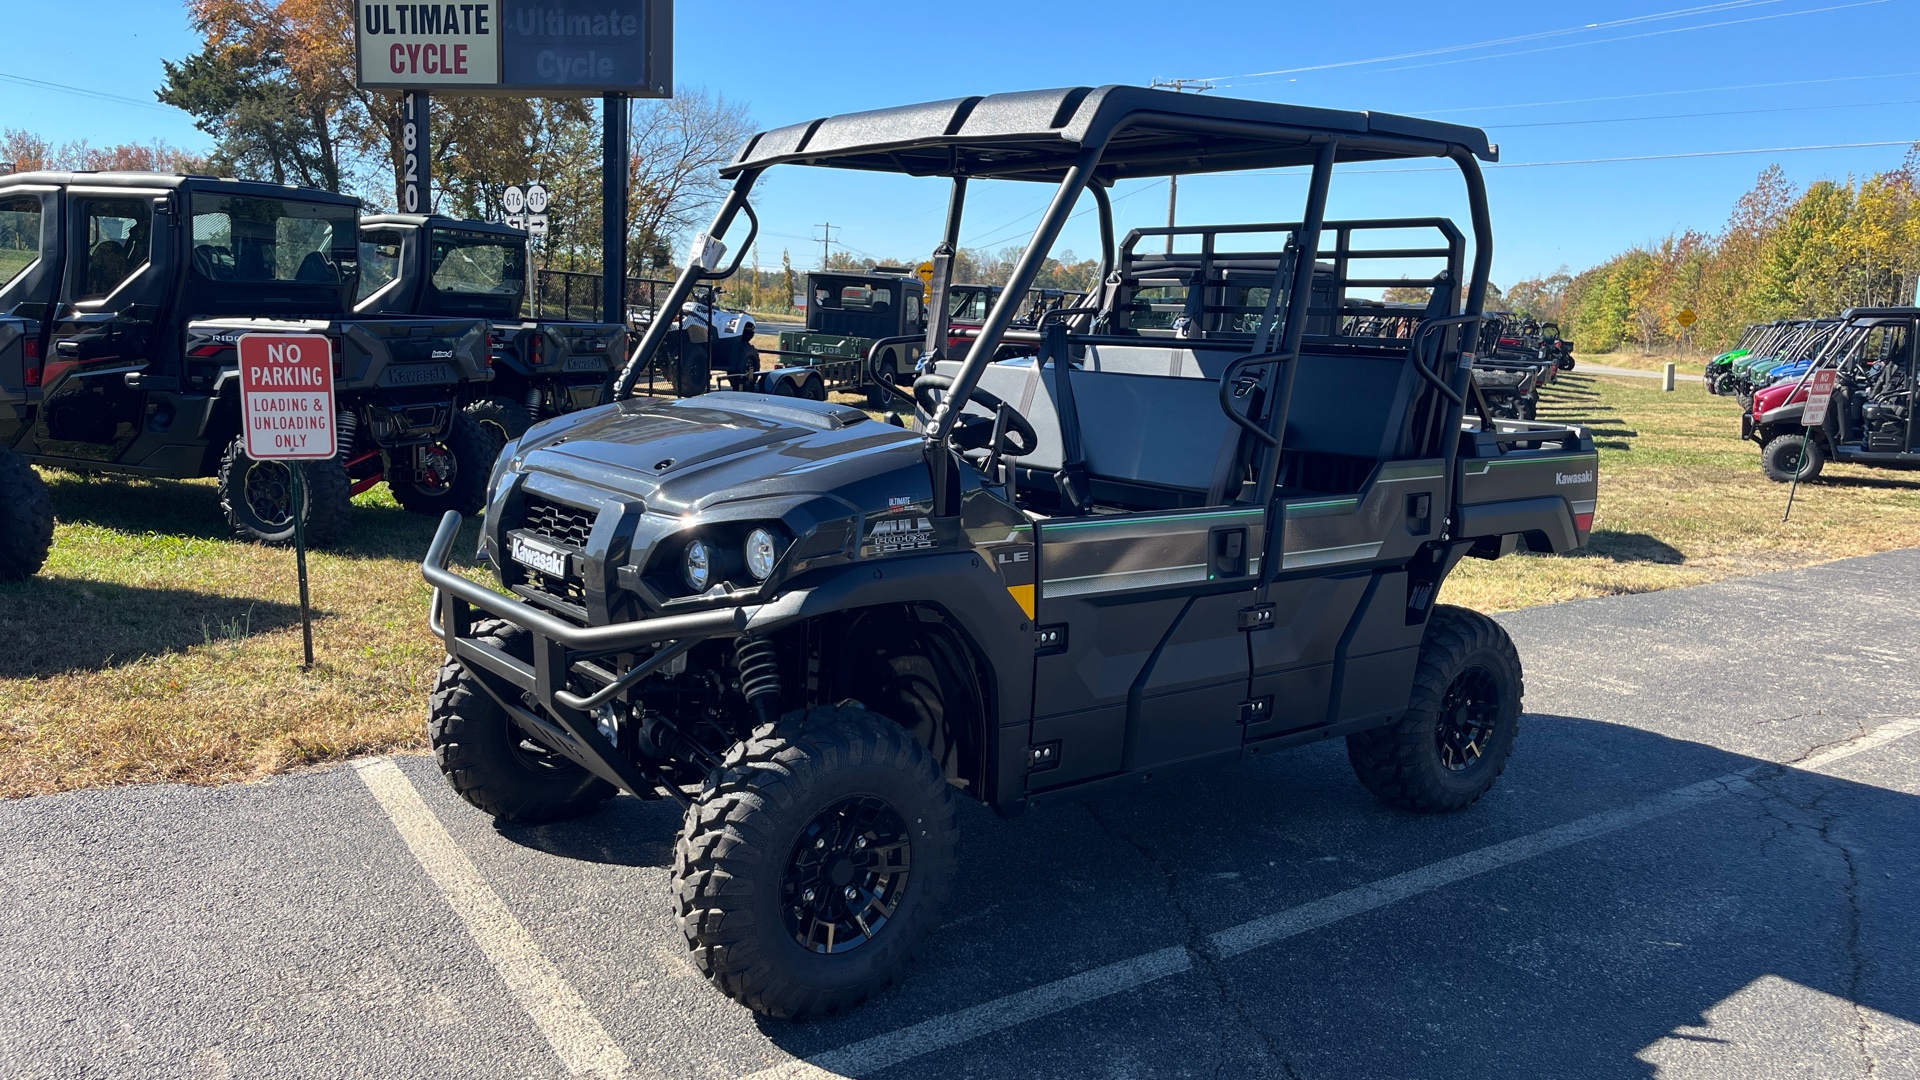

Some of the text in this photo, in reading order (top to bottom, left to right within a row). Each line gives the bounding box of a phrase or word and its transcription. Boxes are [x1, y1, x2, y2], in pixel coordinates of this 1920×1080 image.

[365, 4, 489, 35] ULTIMATE
[516, 8, 638, 36] Ultimate
[390, 43, 468, 74] CYCLE
[537, 49, 614, 84] Cycle
[404, 93, 418, 212] 1820
[506, 193, 521, 206] 676
[529, 192, 545, 205] 675
[268, 344, 302, 363] NO
[251, 366, 323, 386] PARKING
[389, 366, 447, 383] Kawasaki
[1820, 373, 1830, 382] NO
[254, 398, 323, 412] LOADING &
[254, 416, 326, 430] UNLOADING
[275, 434, 307, 448] ONLY
[1555, 470, 1593, 485] Kawasaki
[888, 496, 911, 506] ULTIMATE
[512, 537, 565, 576] Kawasaki
[998, 551, 1029, 564] LE
